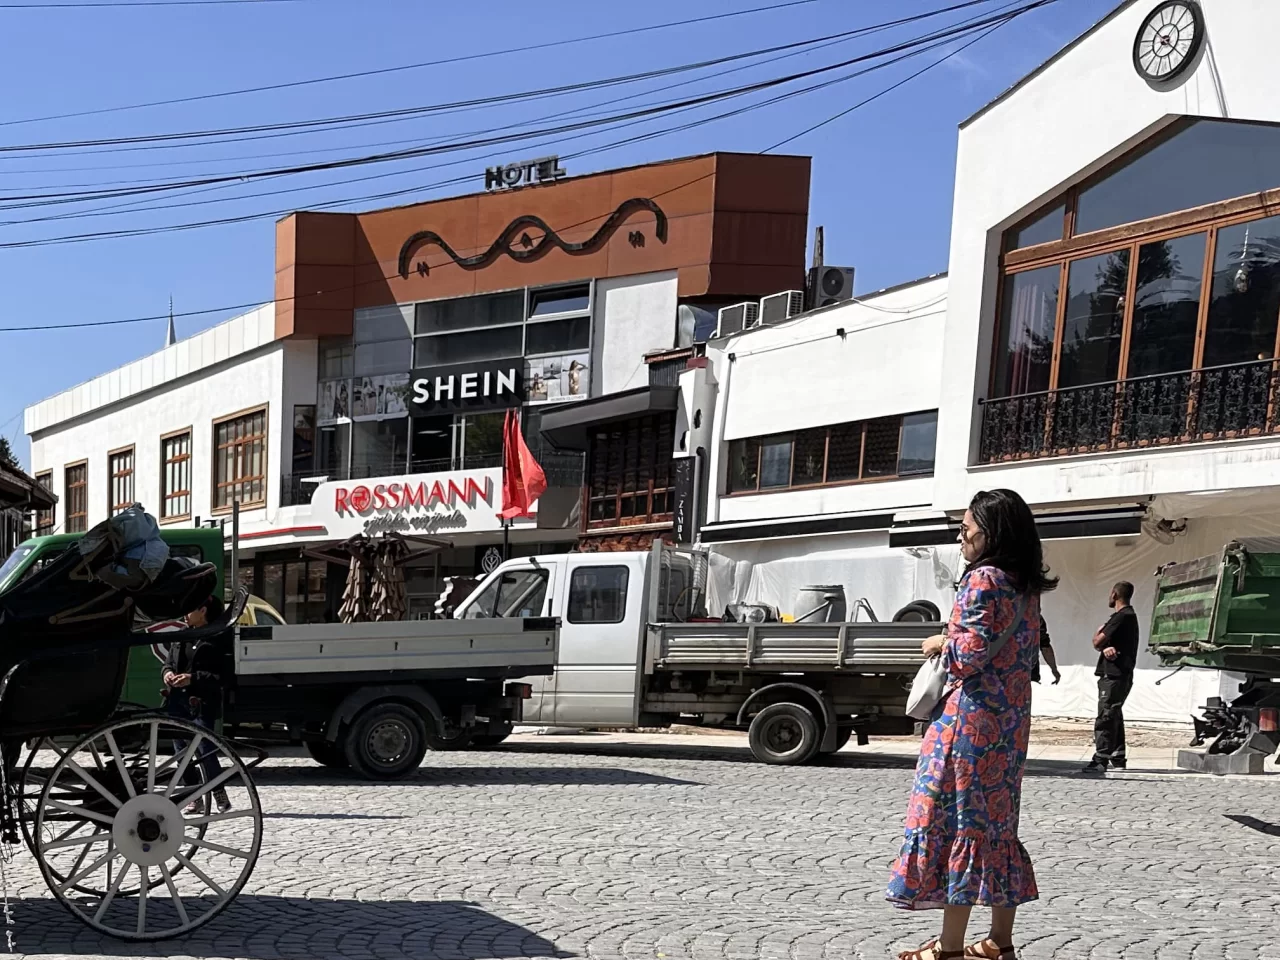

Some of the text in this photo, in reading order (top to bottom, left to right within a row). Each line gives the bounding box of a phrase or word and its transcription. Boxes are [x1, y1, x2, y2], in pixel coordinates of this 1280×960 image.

[485, 154, 566, 188] HOTEL
[412, 368, 516, 404] SHEIN
[335, 475, 489, 513] ROSSMANN
